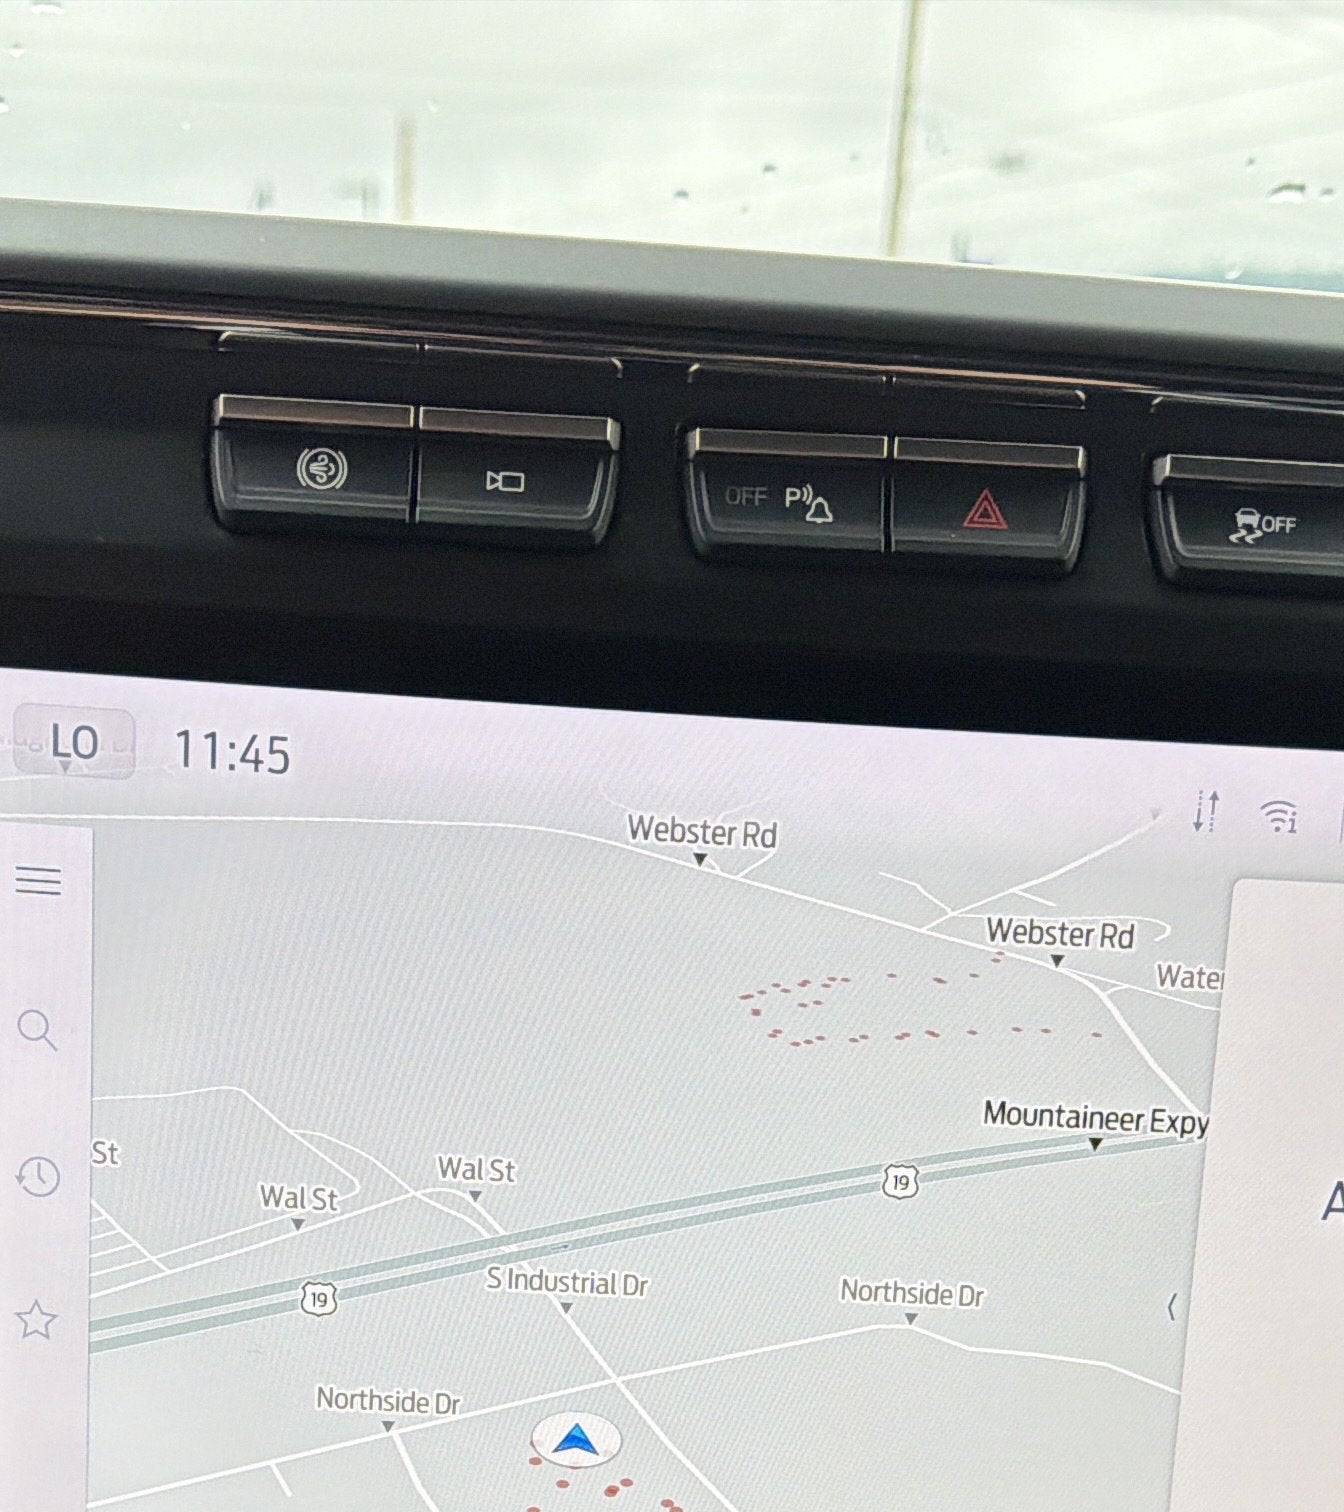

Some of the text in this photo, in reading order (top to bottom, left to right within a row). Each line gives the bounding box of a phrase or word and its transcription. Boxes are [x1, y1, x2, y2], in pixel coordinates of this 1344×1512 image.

[725, 486, 768, 506] OFF
[1261, 515, 1297, 533] OFF
[52, 723, 98, 760] LO
[176, 728, 290, 775] 11:45
[628, 813, 778, 849] Webster Rd
[986, 916, 1135, 951] Webster Rd
[984, 1100, 1209, 1139] Mountaineer Expy
[92, 1141, 118, 1165] St
[438, 1155, 516, 1183] Wal St
[893, 1174, 910, 1190] 19
[260, 1184, 338, 1211] Wal St
[487, 1267, 649, 1297] S Industrial Dr
[841, 1278, 985, 1307] Northside Dr
[310, 1292, 328, 1308] 19
[317, 1387, 461, 1416] Northside Dr
